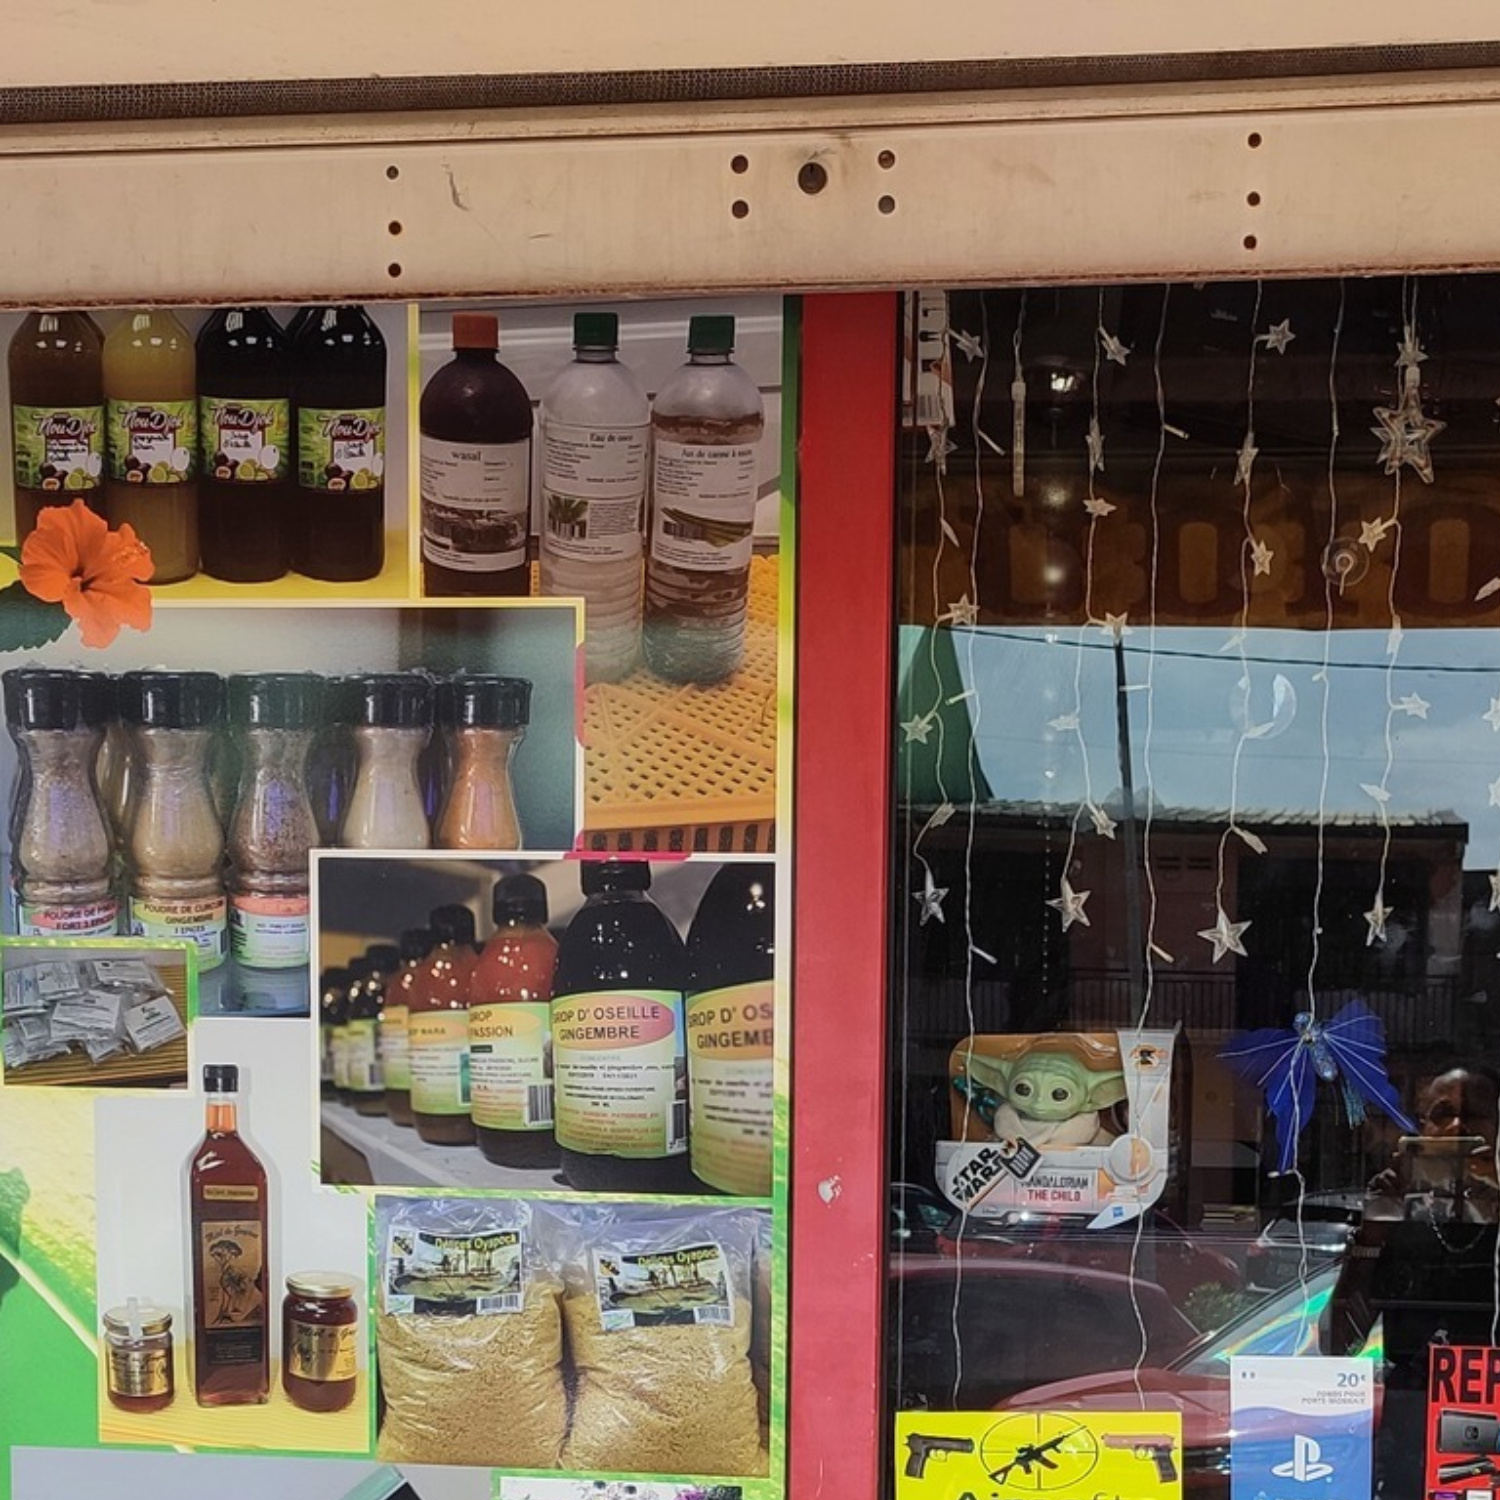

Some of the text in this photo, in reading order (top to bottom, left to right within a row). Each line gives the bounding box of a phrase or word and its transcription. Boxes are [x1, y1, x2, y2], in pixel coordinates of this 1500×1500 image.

[143, 902, 193, 915] POUDRE DE
[593, 1005, 660, 1020] OSEILLE
[559, 1024, 641, 1041] GINGEMBRE
[1027, 1189, 1081, 1201] THE CHILD
